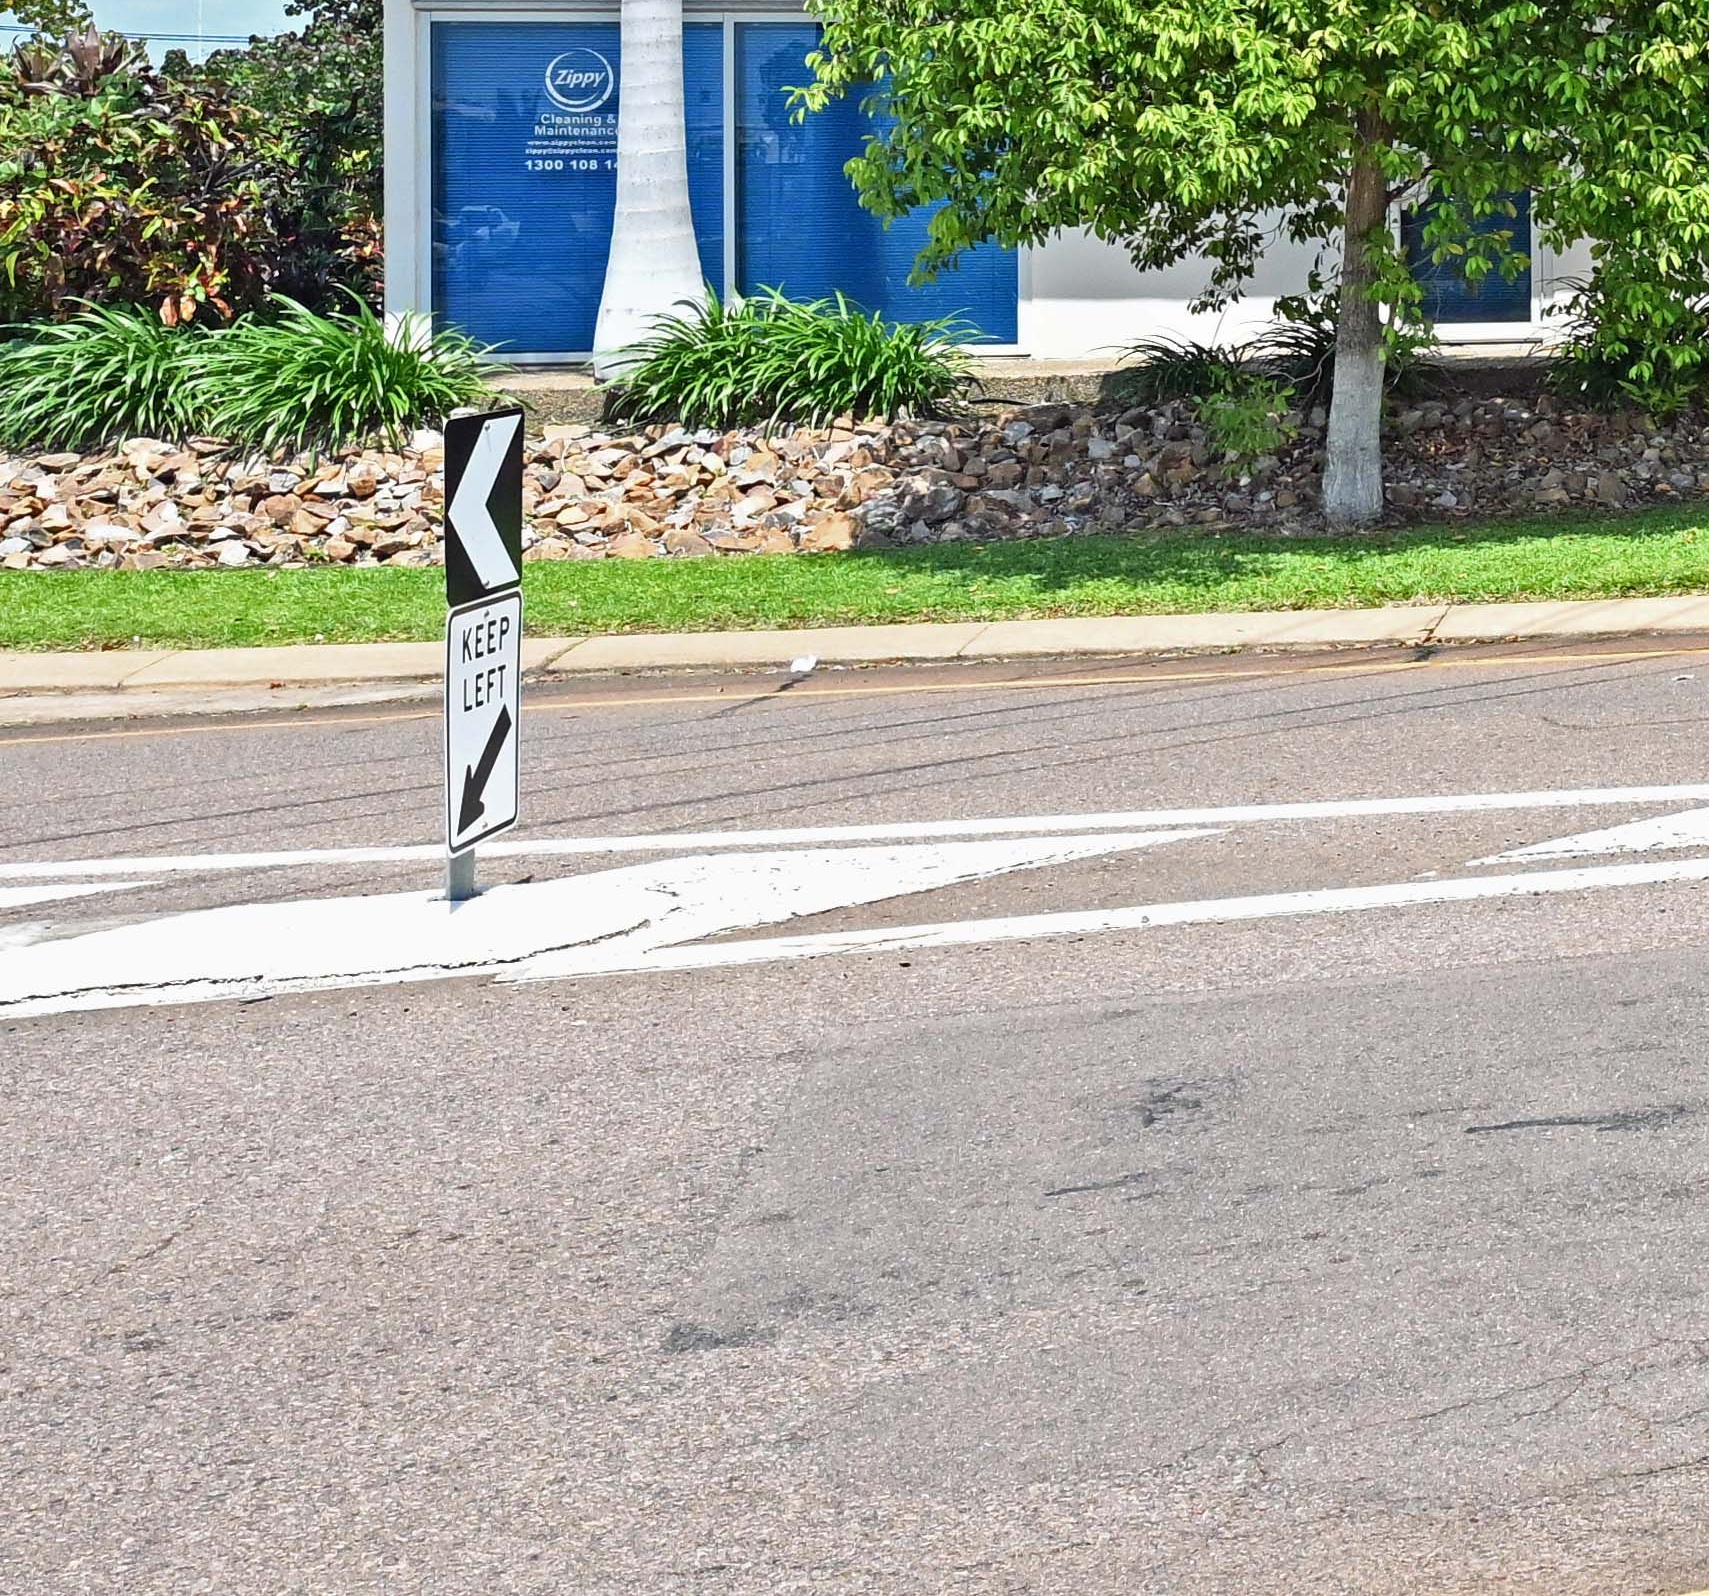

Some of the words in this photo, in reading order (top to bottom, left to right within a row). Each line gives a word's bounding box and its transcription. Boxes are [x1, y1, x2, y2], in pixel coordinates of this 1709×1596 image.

[554, 69, 606, 89] Zippy
[540, 113, 602, 126] Cleaning
[606, 114, 617, 124] &
[525, 159, 564, 171] 1300
[569, 159, 598, 171] 108
[462, 616, 510, 664] KEEP
[463, 664, 507, 713] LEFT
